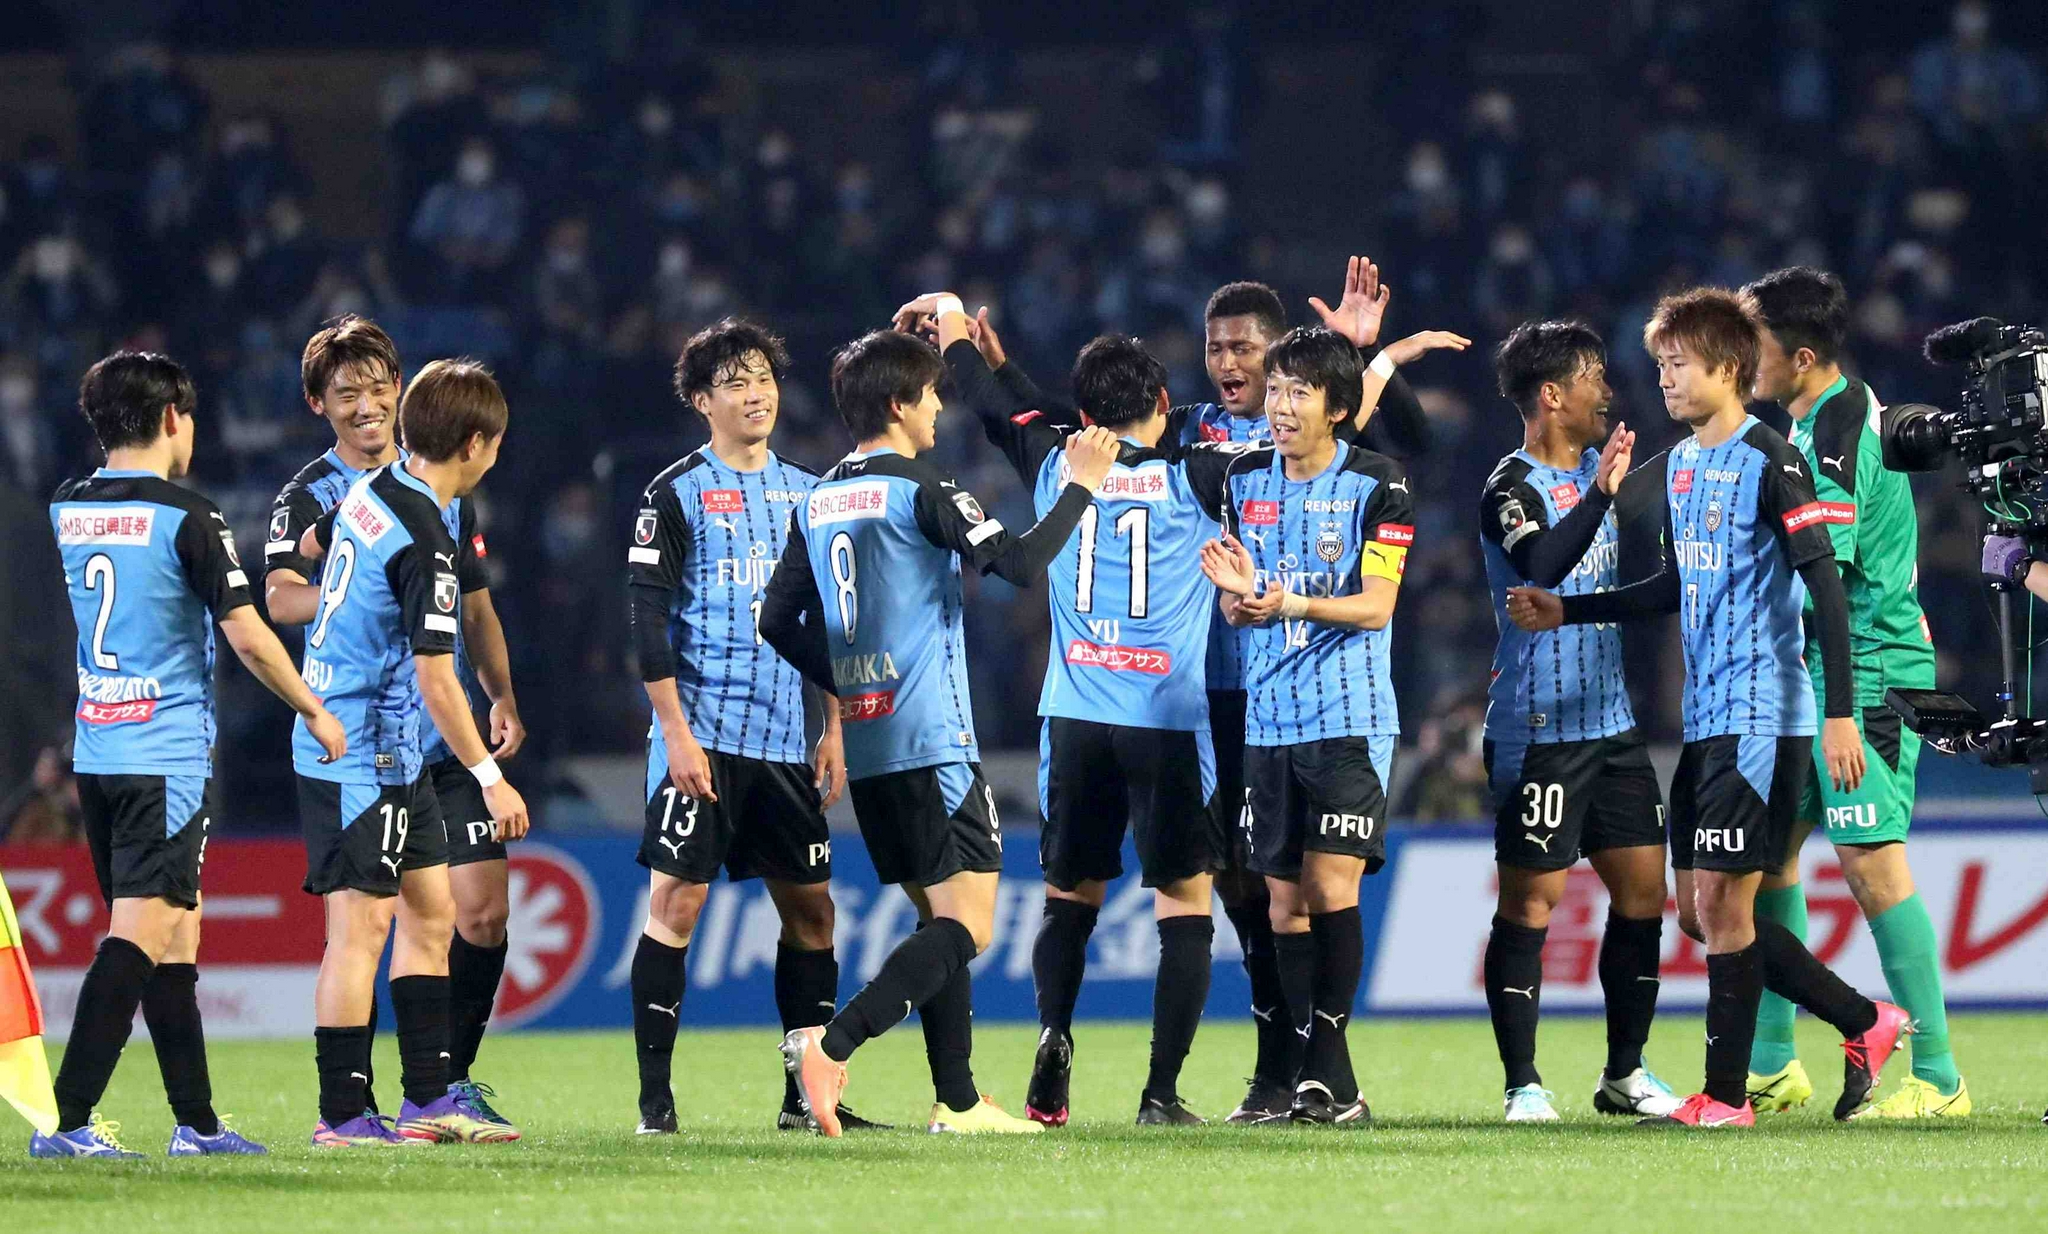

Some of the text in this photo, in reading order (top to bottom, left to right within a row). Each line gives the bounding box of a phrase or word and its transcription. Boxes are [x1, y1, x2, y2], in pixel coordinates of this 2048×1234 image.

[1704, 469, 1741, 483] RENOSY
[1304, 498, 1357, 513] RENOSY
[59, 516, 148, 537] SMBC日興証券
[716, 558, 779, 596] FUJIT
[1073, 503, 1150, 619] 11
[829, 530, 858, 646] 8
[1686, 583, 1698, 630] 7
[83, 552, 120, 671] 2
[1088, 619, 1120, 645] YU
[301, 654, 333, 692] ABU
[662, 786, 700, 837] 13
[984, 784, 999, 830] 8
[1521, 782, 1564, 829] 30
[1826, 803, 1877, 829] PFU
[380, 803, 408, 854] 19
[1320, 813, 1375, 840] PFU
[1694, 828, 1745, 852] PFU
